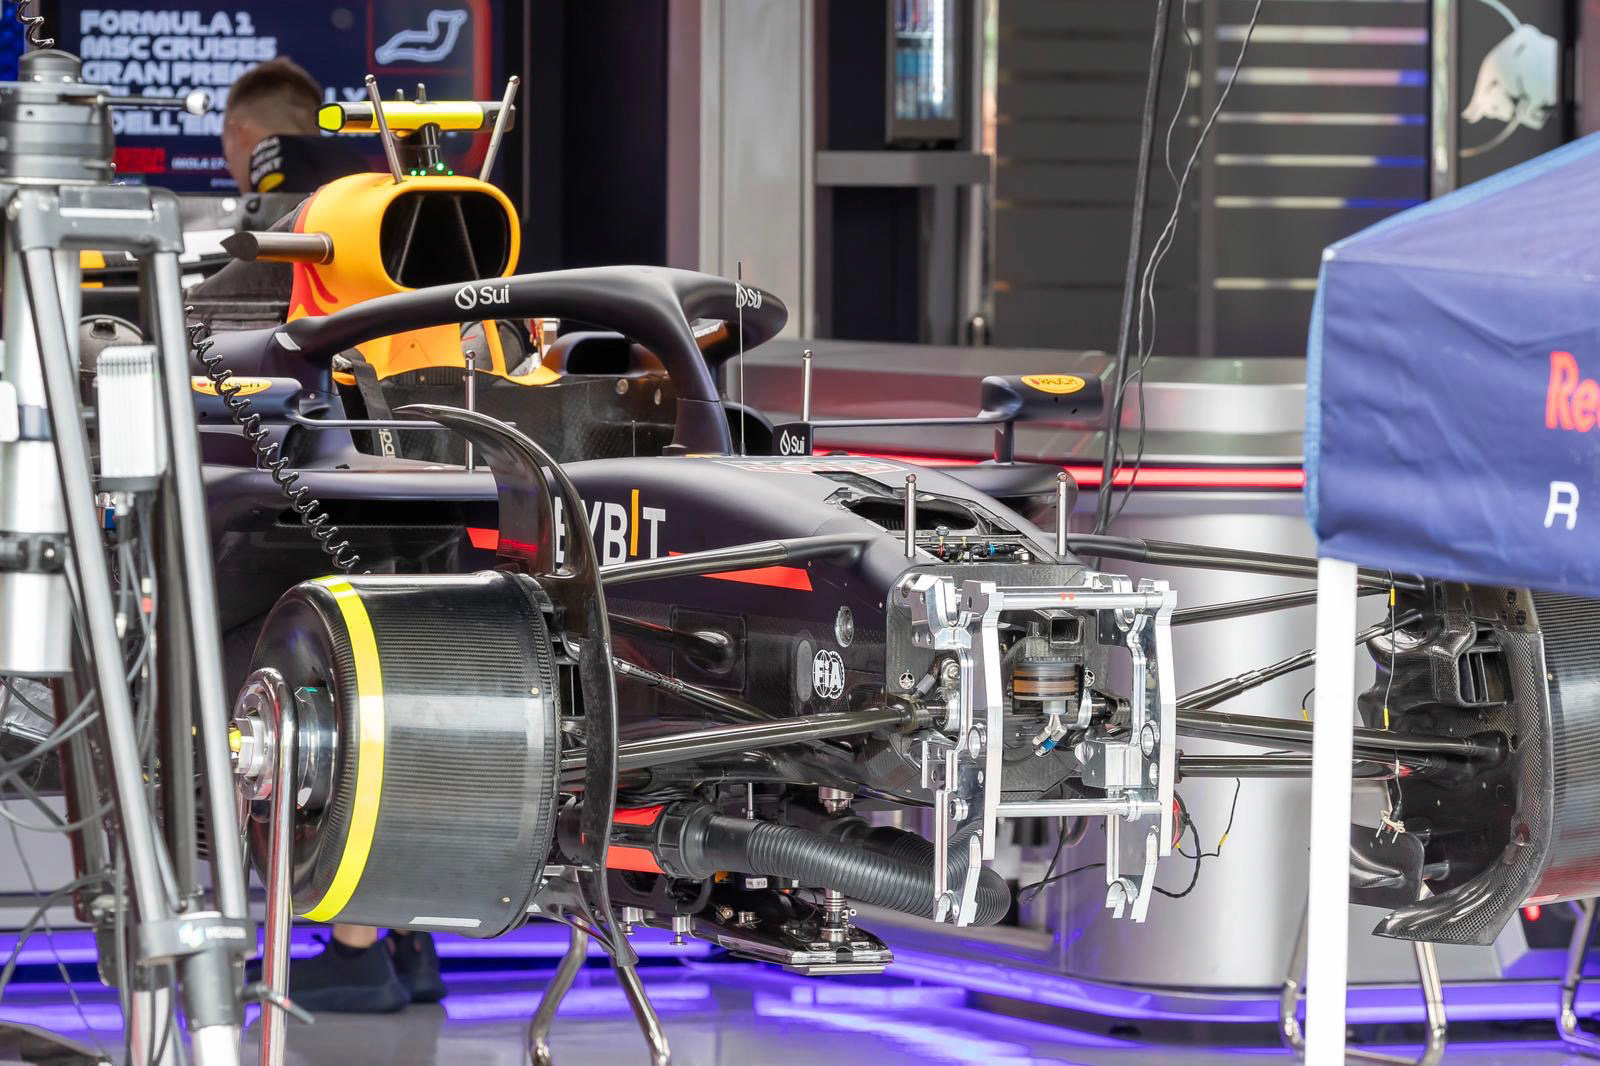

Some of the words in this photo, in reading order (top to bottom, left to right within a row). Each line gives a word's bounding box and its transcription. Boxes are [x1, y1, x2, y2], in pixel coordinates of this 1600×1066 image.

[80, 9, 233, 35] FORMULA
[235, 11, 255, 35] 1
[80, 35, 150, 60] MSC
[152, 36, 277, 61] CRUISES
[81, 60, 170, 84] GRAN
[480, 284, 510, 305] Sui
[747, 288, 762, 309] Sui
[1545, 351, 1600, 432] Re
[791, 436, 805, 454] Sui
